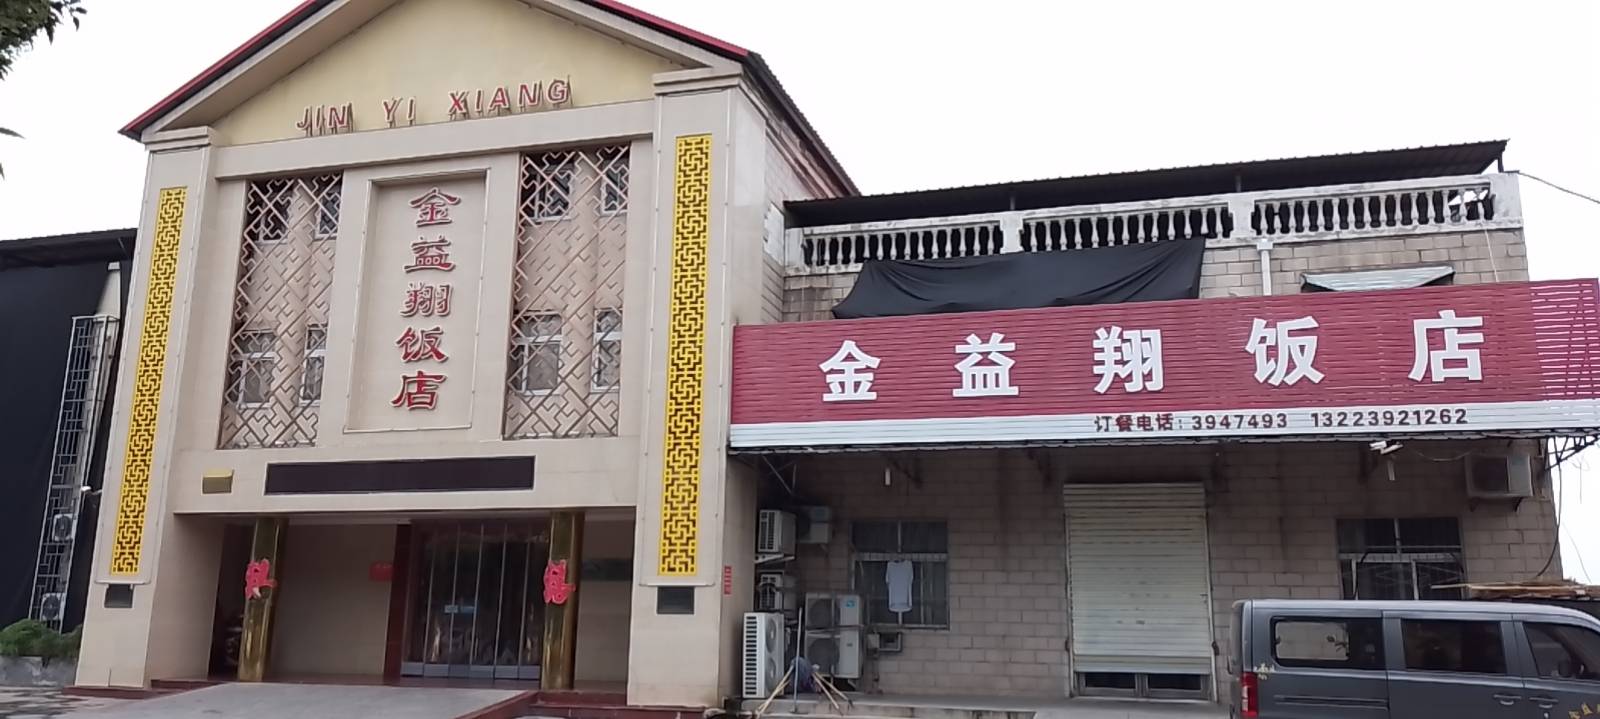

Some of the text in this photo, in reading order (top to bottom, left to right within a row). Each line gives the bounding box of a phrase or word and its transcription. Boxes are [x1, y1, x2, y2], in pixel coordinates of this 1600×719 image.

[296, 79, 570, 130] JIN YI XIANG
[391, 187, 461, 411] 金益翔饭店
[819, 308, 1485, 403] 金益翔饭店
[1310, 408, 1469, 429] 13223921262
